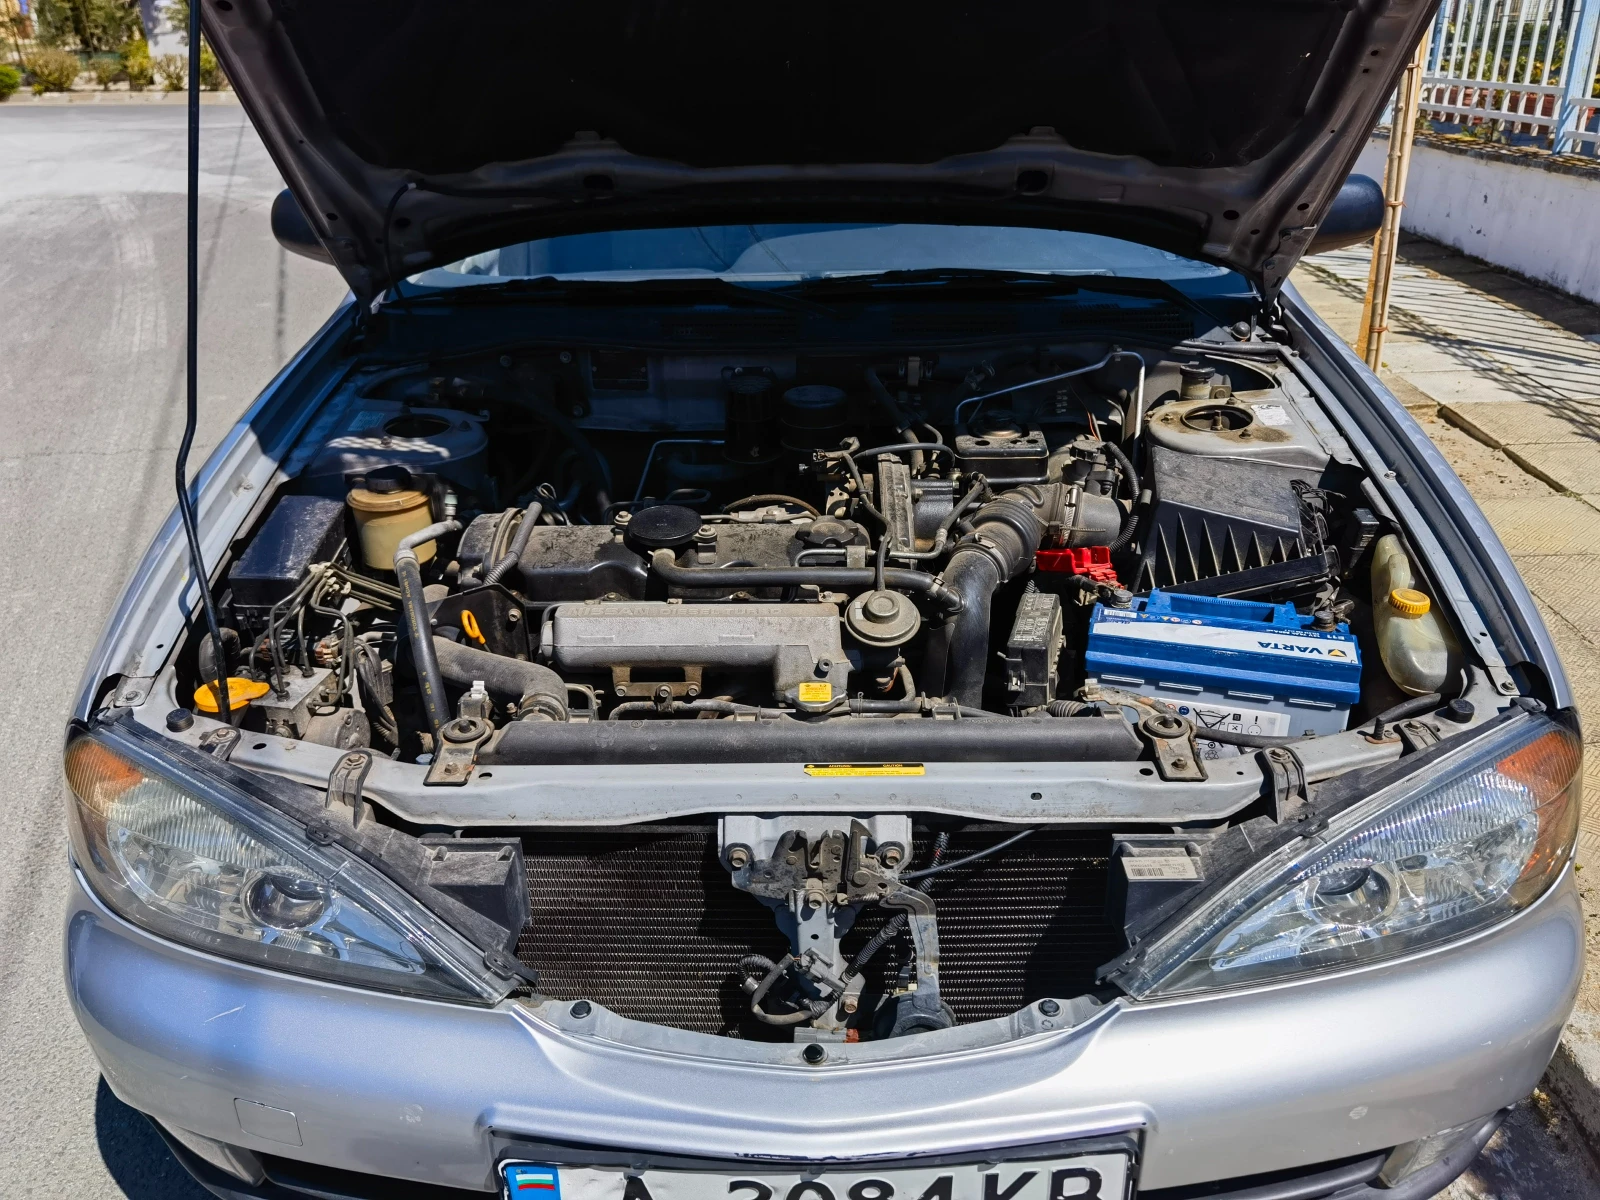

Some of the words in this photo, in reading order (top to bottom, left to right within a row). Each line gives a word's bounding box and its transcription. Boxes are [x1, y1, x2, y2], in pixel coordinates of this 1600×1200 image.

[567, 607, 650, 615] NISSAN
[660, 607, 719, 615] DIESEL
[1257, 641, 1323, 655] VARTA
